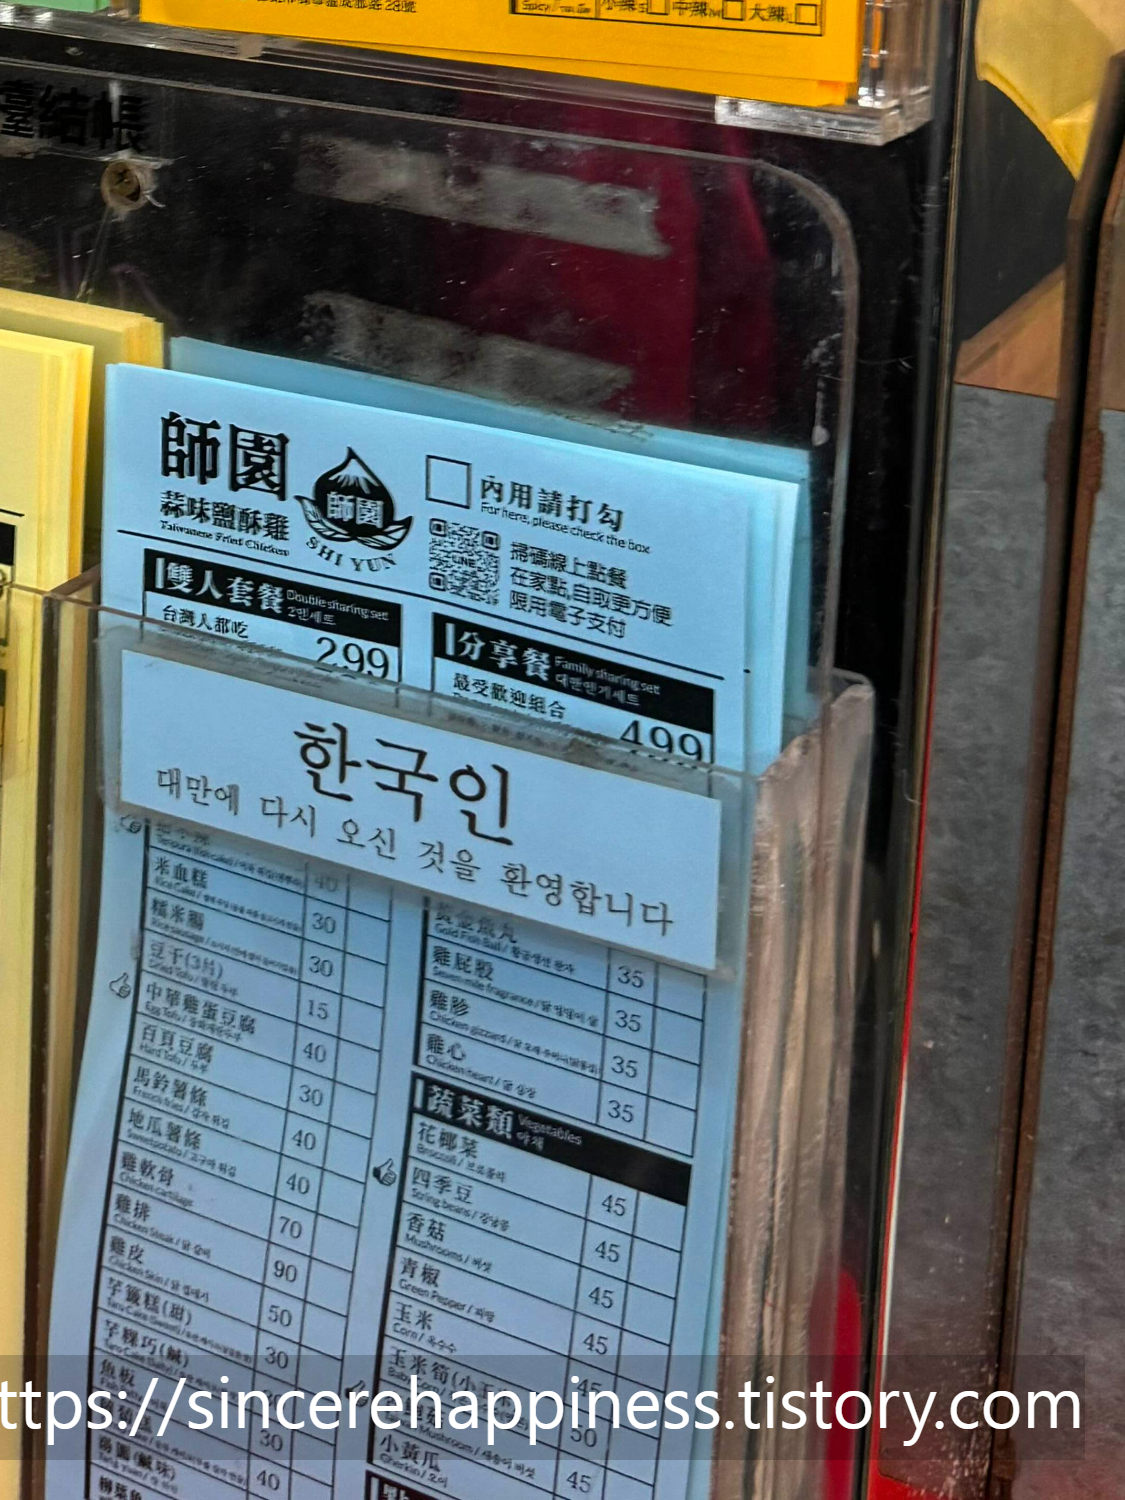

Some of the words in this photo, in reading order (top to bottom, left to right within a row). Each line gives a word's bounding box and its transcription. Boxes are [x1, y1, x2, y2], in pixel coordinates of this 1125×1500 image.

[161, 411, 290, 501] 師園
[326, 491, 384, 528] 師園
[480, 476, 624, 532] 內用請打勾
[167, 562, 284, 615] 雙人套餐
[316, 636, 390, 680] 299
[457, 630, 550, 683] 分享餐
[620, 719, 703, 762] 499
[293, 721, 514, 846] 한국인
[156, 767, 241, 817] 대만에
[261, 794, 316, 837] 다시
[337, 817, 398, 861] 오신
[420, 840, 481, 884] 것을
[500, 861, 674, 937] 환영합니다
[312, 912, 336, 934] 30
[309, 955, 334, 978] 30
[617, 965, 644, 990] 35
[307, 999, 329, 1021] 15
[615, 1009, 642, 1033] 35
[302, 1041, 326, 1064] 40
[611, 1056, 638, 1080] 35
[299, 1085, 323, 1107] 30
[428, 1085, 513, 1140] 蔬菜類
[607, 1099, 634, 1123] 35
[292, 1129, 316, 1151] 40
[286, 1173, 310, 1195] 40
[412, 1167, 473, 1204] 四季豆
[601, 1193, 626, 1216] 45
[278, 1216, 302, 1239] 70
[406, 1211, 447, 1242] 香菇
[595, 1240, 620, 1263] 45
[273, 1259, 297, 1283] 90
[589, 1286, 614, 1309] 45
[268, 1305, 292, 1328] 50
[394, 1300, 435, 1331] 玉米
[583, 1333, 609, 1356] 45
[264, 1347, 289, 1369] 30
[566, 1470, 592, 1493] 45
